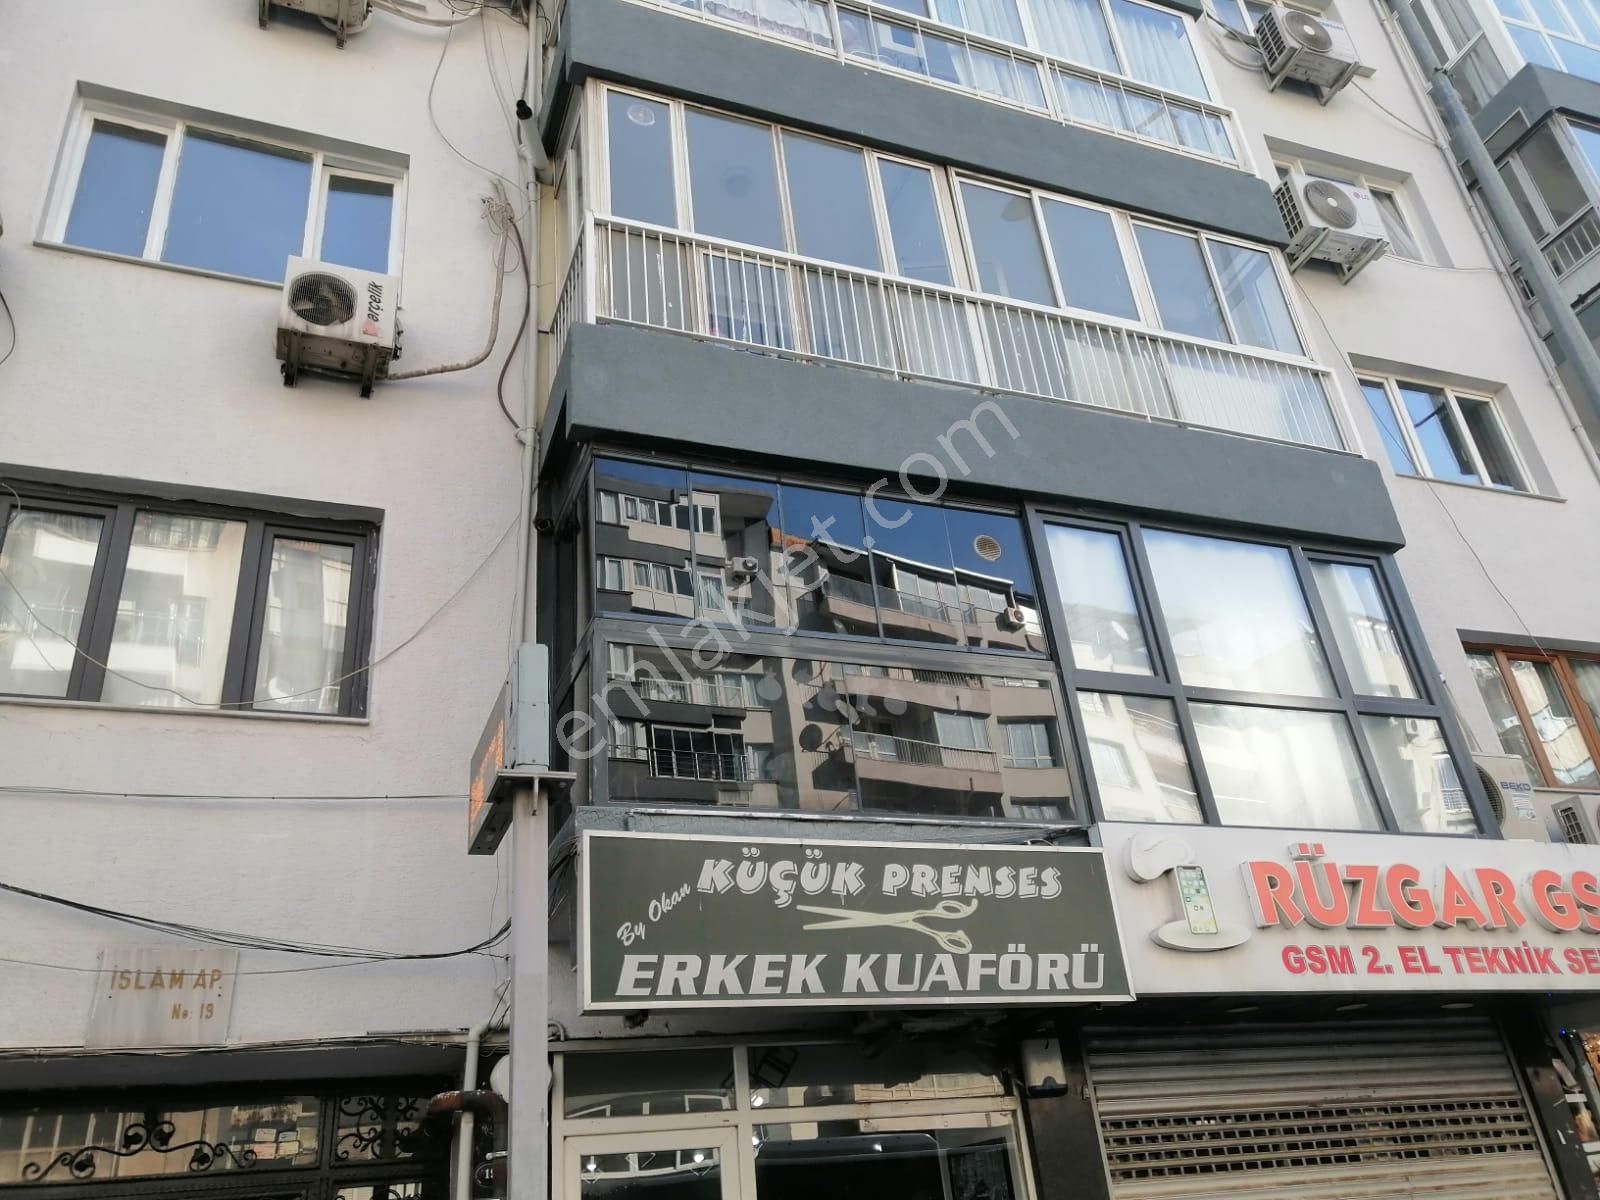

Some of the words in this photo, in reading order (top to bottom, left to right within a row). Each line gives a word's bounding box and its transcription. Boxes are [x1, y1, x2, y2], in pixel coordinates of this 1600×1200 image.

[367, 281, 384, 323] arçelik
[697, 847, 866, 908] KÜÇÜK
[881, 863, 1063, 900] PRENSES
[1241, 842, 1527, 930] RÜZGAR
[616, 921, 646, 947] By
[648, 882, 691, 922] Okan
[615, 954, 828, 996] ERKEK
[842, 943, 1104, 992] KUAFÖRÜ
[1281, 944, 1357, 975] GSM
[1361, 945, 1394, 975] 2.
[1397, 945, 1443, 975] EL
[1443, 941, 1563, 976] TEKNİK
